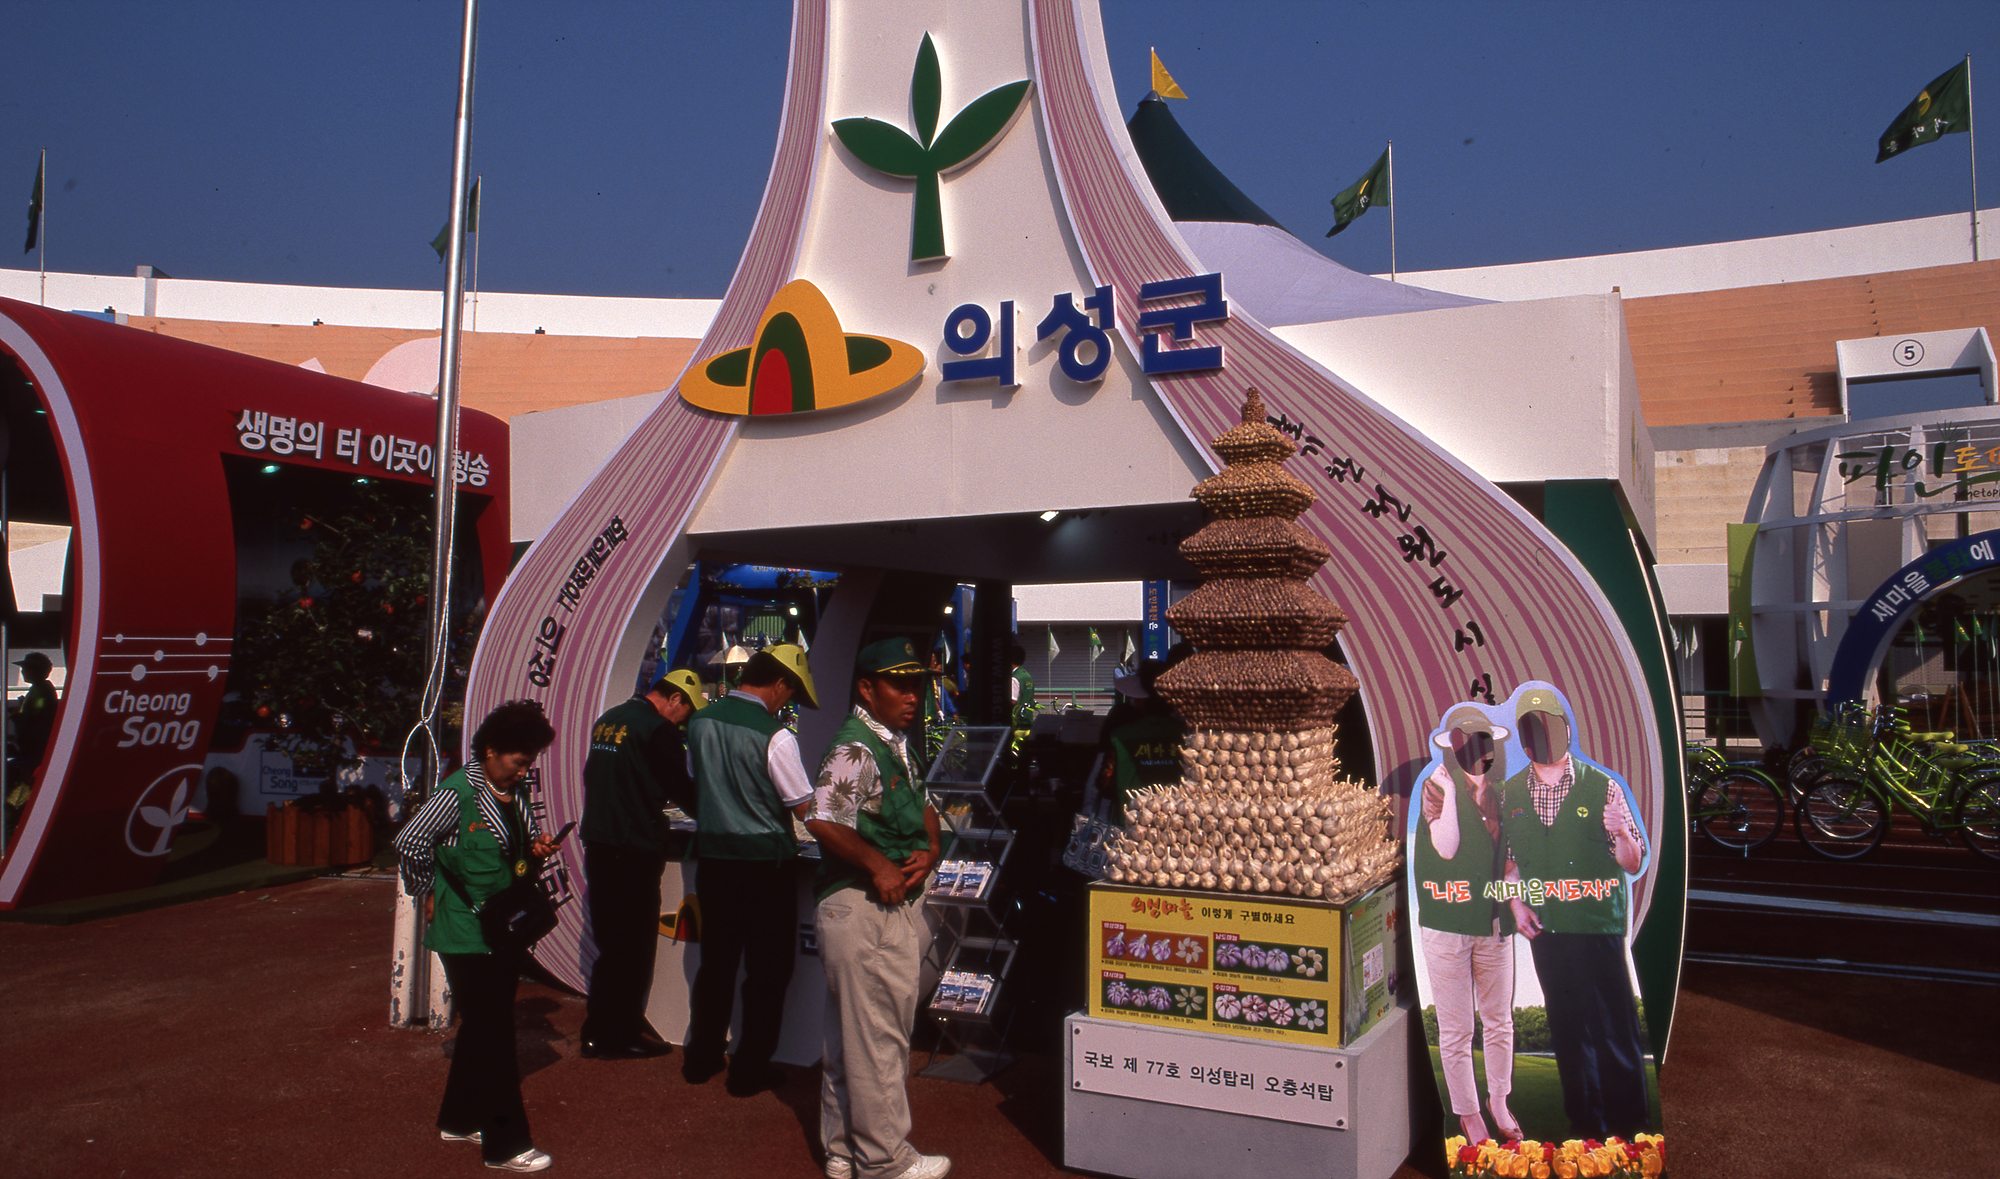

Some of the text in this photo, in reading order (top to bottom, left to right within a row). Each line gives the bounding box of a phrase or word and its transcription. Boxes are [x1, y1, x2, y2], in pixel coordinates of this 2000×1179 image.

[942, 272, 1230, 386] 의성군
[1903, 345, 1915, 360] 5
[236, 409, 324, 460] 생명의
[336, 428, 361, 465] 터
[451, 449, 490, 487] 청송
[1871, 571, 1930, 622] 새마을
[528, 616, 566, 688] 의성
[104, 689, 191, 716] Cheong
[117, 716, 201, 750] Song
[262, 765, 291, 778] Cheong
[270, 776, 298, 792] Song
[1130, 896, 1295, 925] 의성마늘 이렇게 구별하세요
[1084, 1051, 1334, 1102] 국보 제 77호 의성탑리 오층석탑
